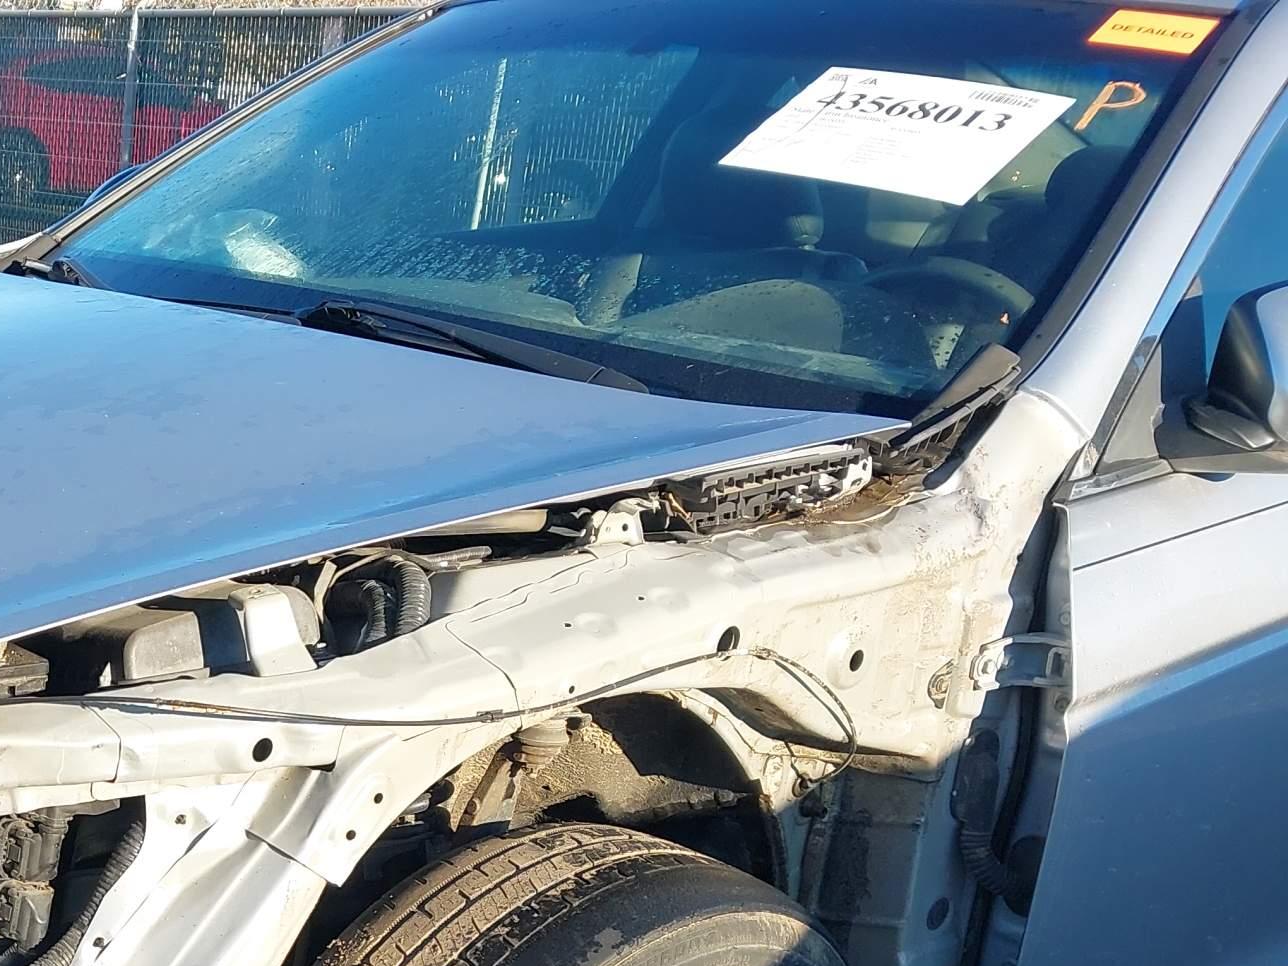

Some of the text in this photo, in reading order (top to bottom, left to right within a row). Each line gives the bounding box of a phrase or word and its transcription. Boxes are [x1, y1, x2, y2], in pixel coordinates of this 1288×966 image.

[1111, 23, 1195, 39] DETAILED
[817, 90, 1014, 131] 43568013
[1074, 81, 1147, 131] P
